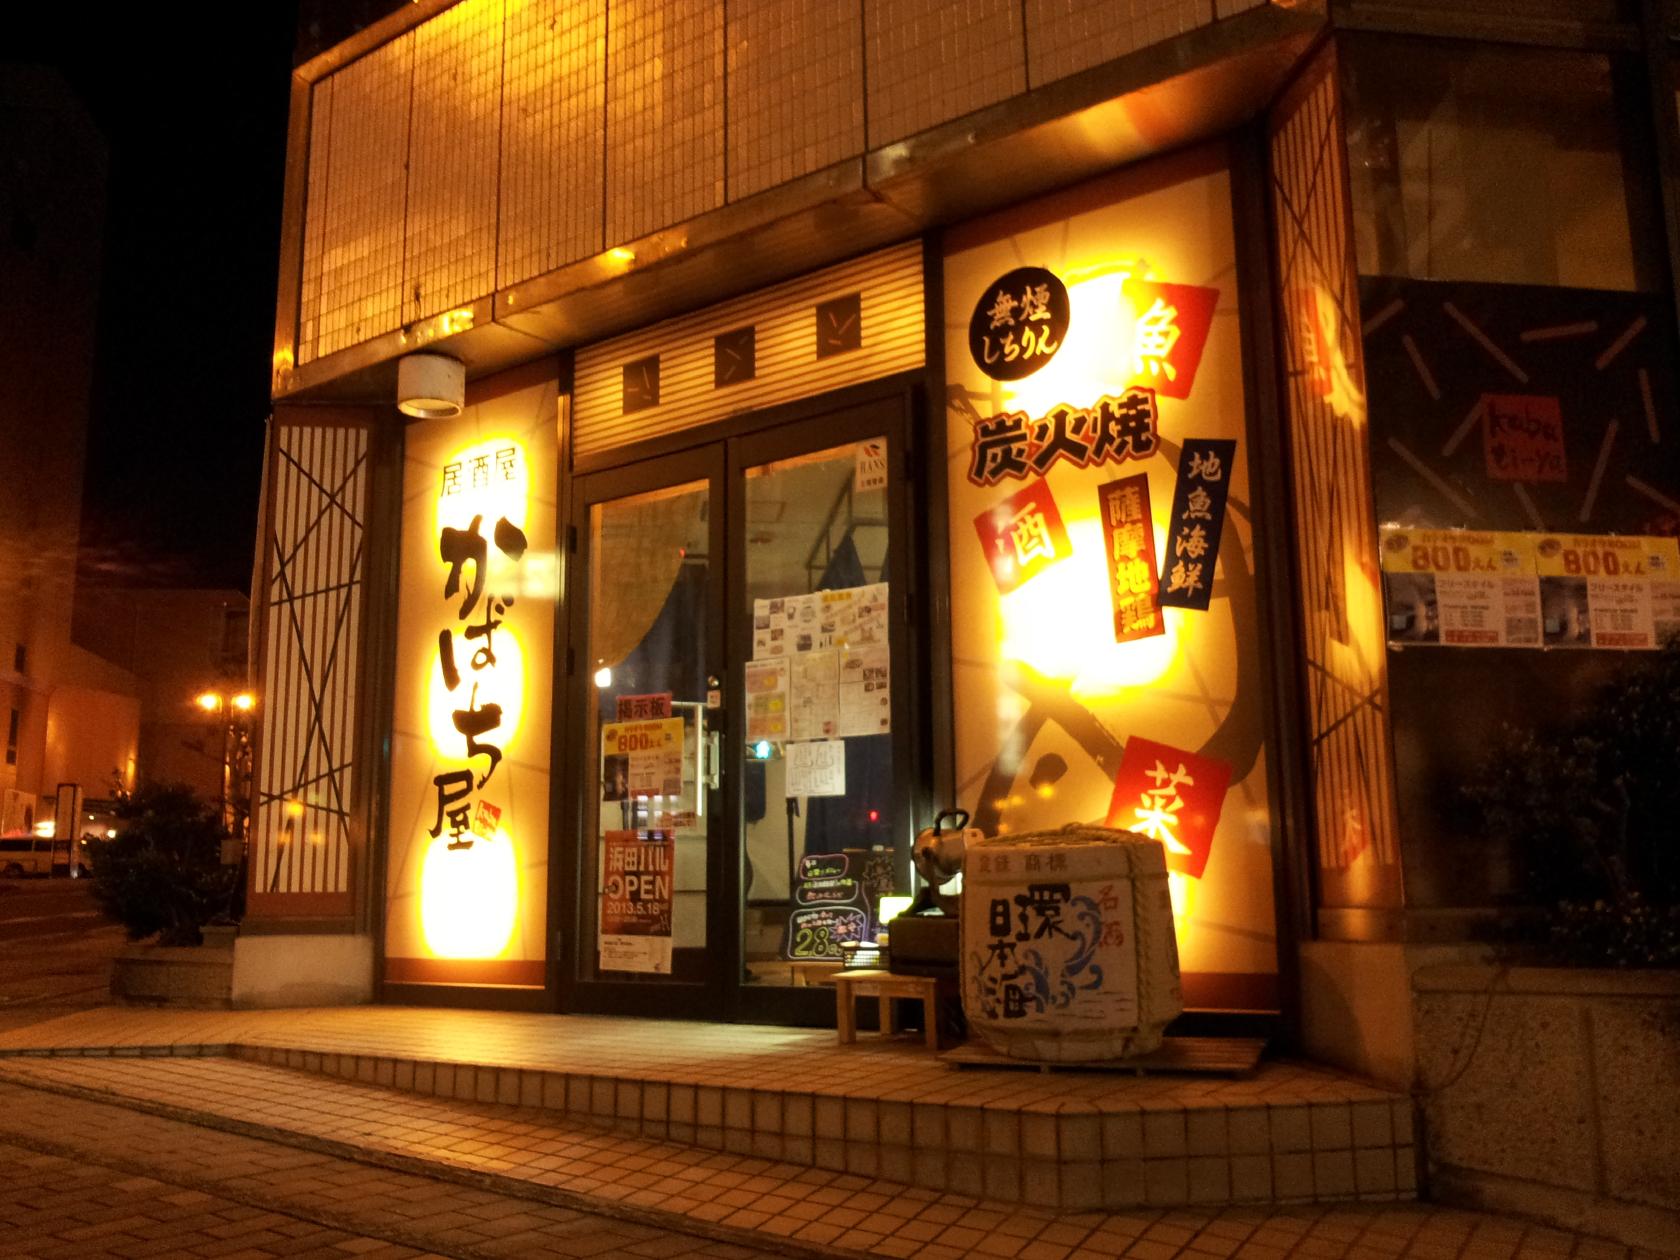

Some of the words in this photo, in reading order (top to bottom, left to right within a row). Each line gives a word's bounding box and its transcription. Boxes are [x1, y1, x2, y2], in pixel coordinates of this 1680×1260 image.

[983, 325, 1059, 364] しちりん
[986, 283, 1052, 330] 無煙
[1134, 297, 1182, 382] 魚
[440, 446, 518, 497] 居酒屋
[968, 388, 1157, 485] 炭火焼
[995, 502, 1056, 575] 酒
[1106, 486, 1156, 635] 薩摩地鶏
[1166, 450, 1222, 598] 地魚海鮮
[429, 513, 528, 851] かばち屋
[1128, 759, 1195, 855] 菜
[608, 874, 670, 900] OPEN
